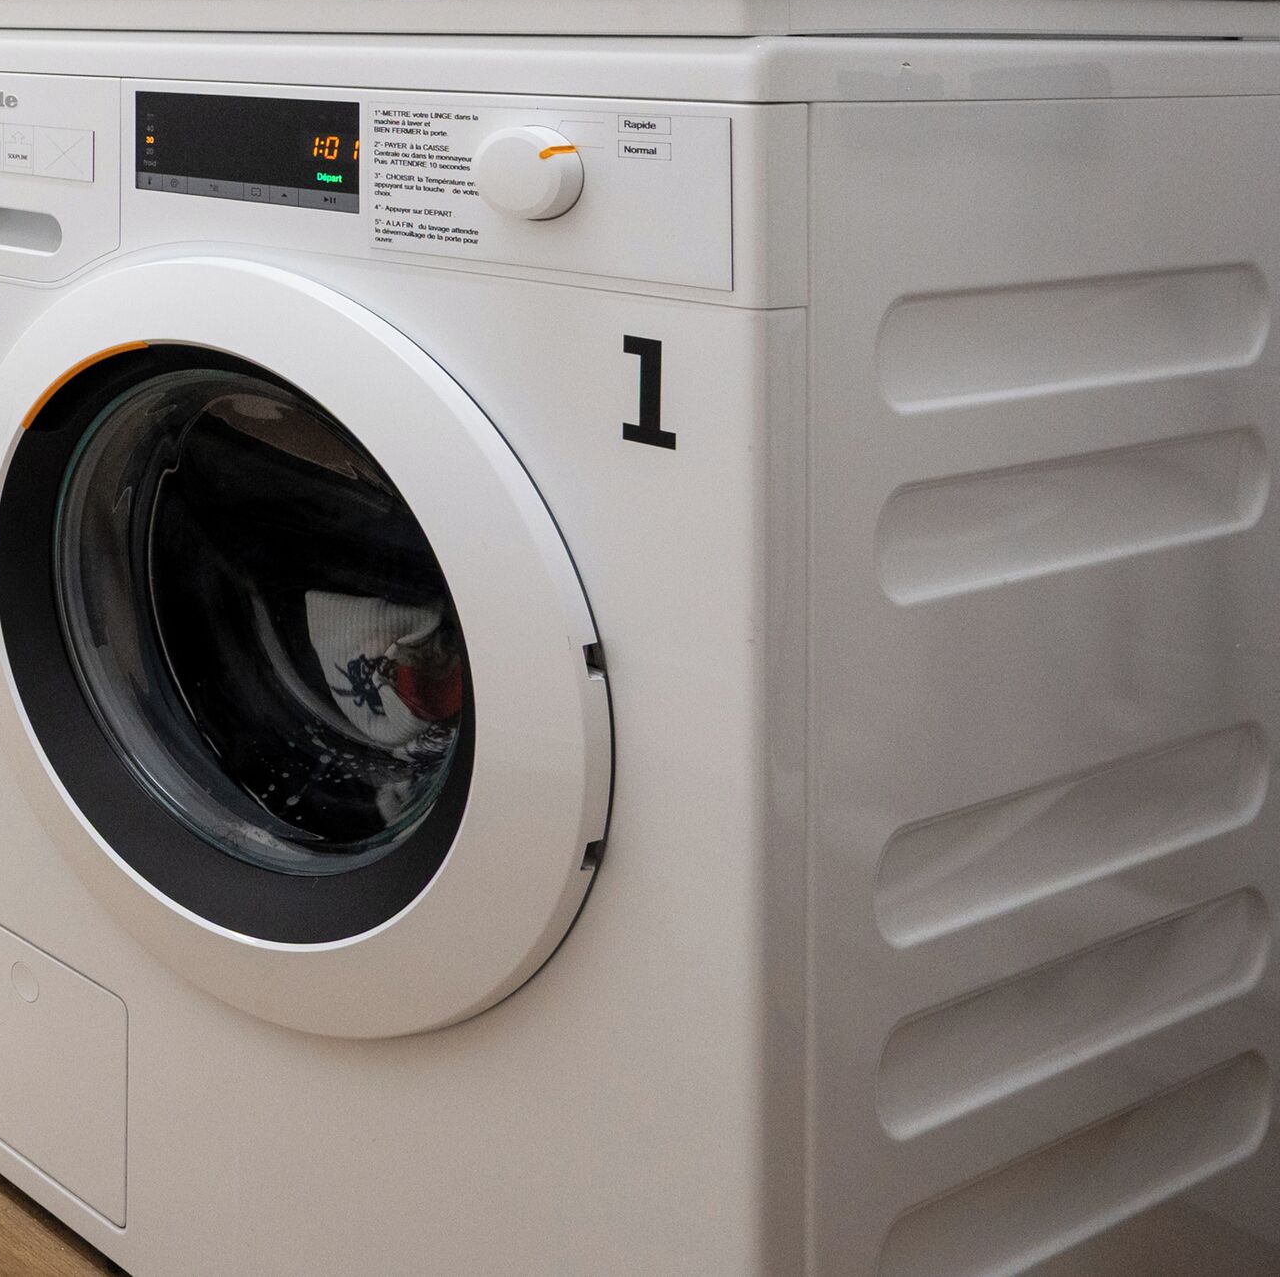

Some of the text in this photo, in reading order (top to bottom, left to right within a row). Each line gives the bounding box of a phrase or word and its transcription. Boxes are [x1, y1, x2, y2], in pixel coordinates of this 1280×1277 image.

[430, 112, 452, 120] LINGE
[454, 113, 471, 121] dans
[624, 120, 656, 130] Rapide
[392, 127, 421, 135] FERMER
[145, 136, 155, 144] 30
[423, 144, 450, 152] CAISSE
[624, 146, 657, 155] Normal
[436, 155, 472, 163] monnayeur
[390, 159, 428, 168] ATTENDRE
[439, 163, 471, 171] secondes
[317, 172, 342, 183] Départ
[386, 173, 415, 182] CHOISIR
[425, 176, 466, 186] Température
[374, 182, 403, 190] appuyant
[423, 185, 445, 193] touche
[385, 205, 411, 214] Appuyer
[428, 225, 450, 234] lavage
[451, 228, 479, 236] attendre
[382, 228, 426, 239] déverrouillage
[444, 235, 461, 243] porte
[463, 237, 478, 245] pour
[622, 335, 677, 450] 1
